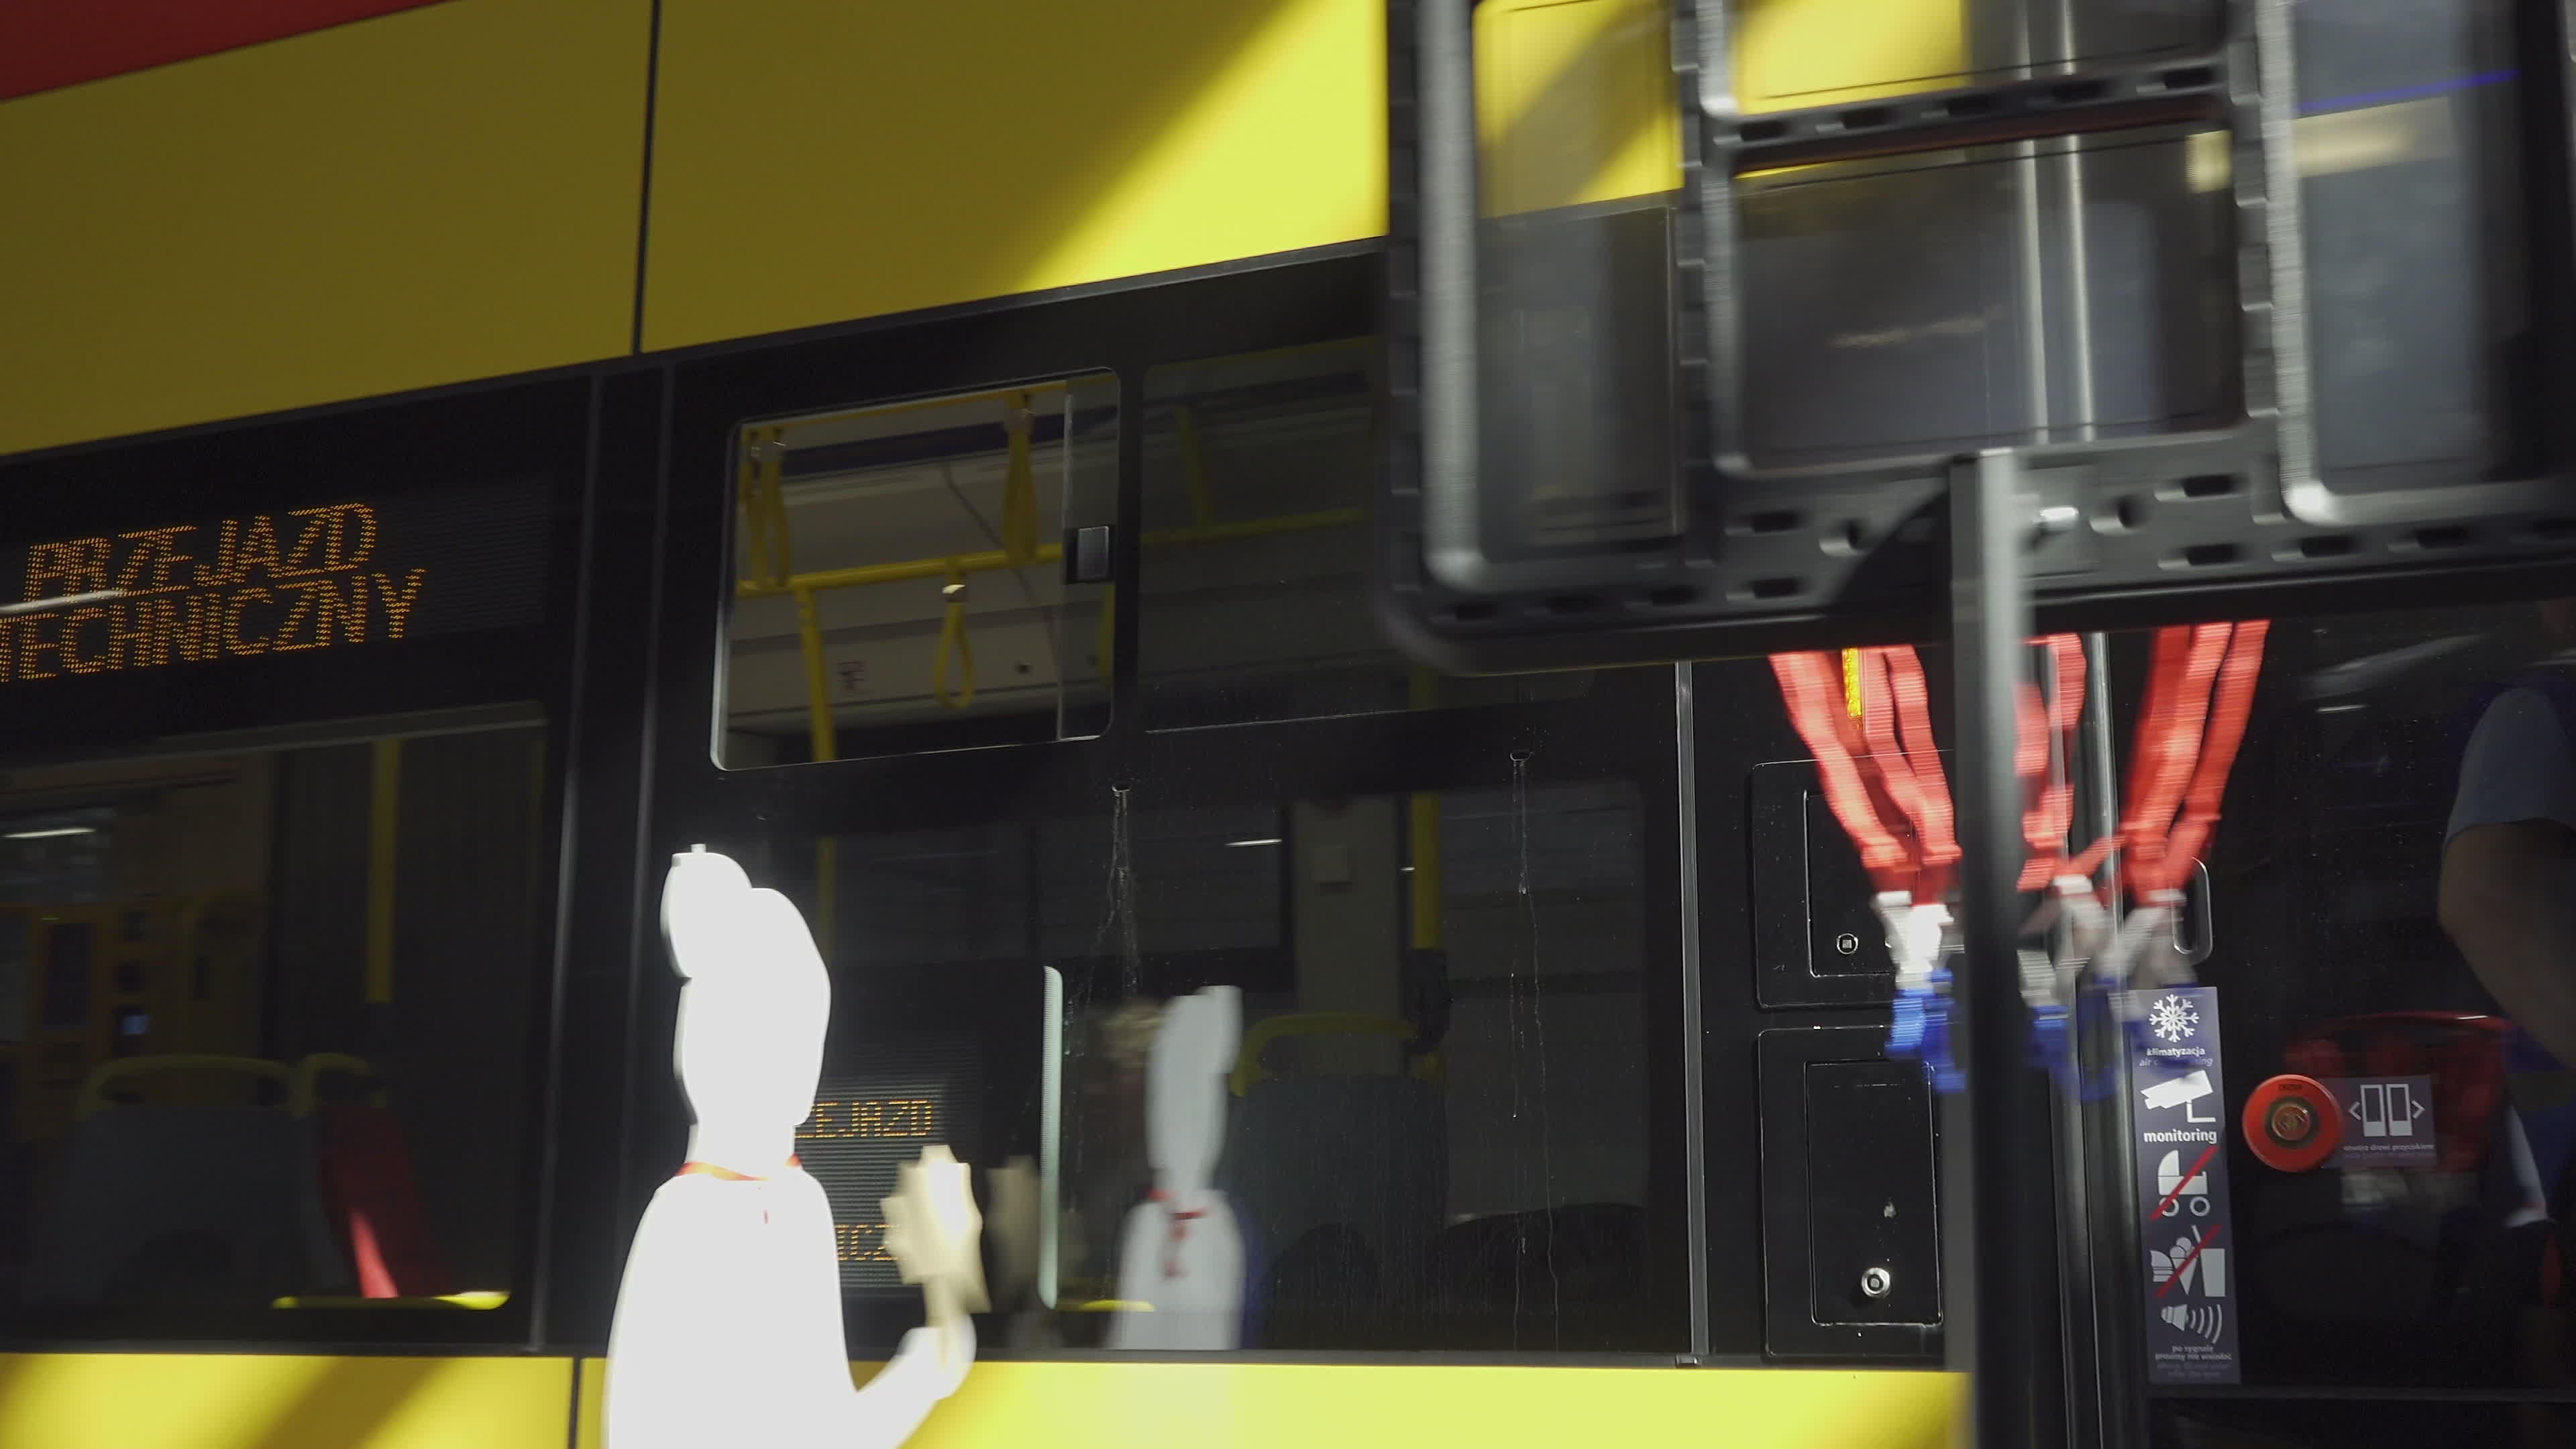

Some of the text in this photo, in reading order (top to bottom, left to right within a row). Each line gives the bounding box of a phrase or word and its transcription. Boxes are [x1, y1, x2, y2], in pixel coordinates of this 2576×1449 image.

[22, 502, 378, 603] PRZEJAZD
[2147, 1046, 2206, 1058] klimatyzacja
[2143, 1128, 2217, 1144] monitoring
